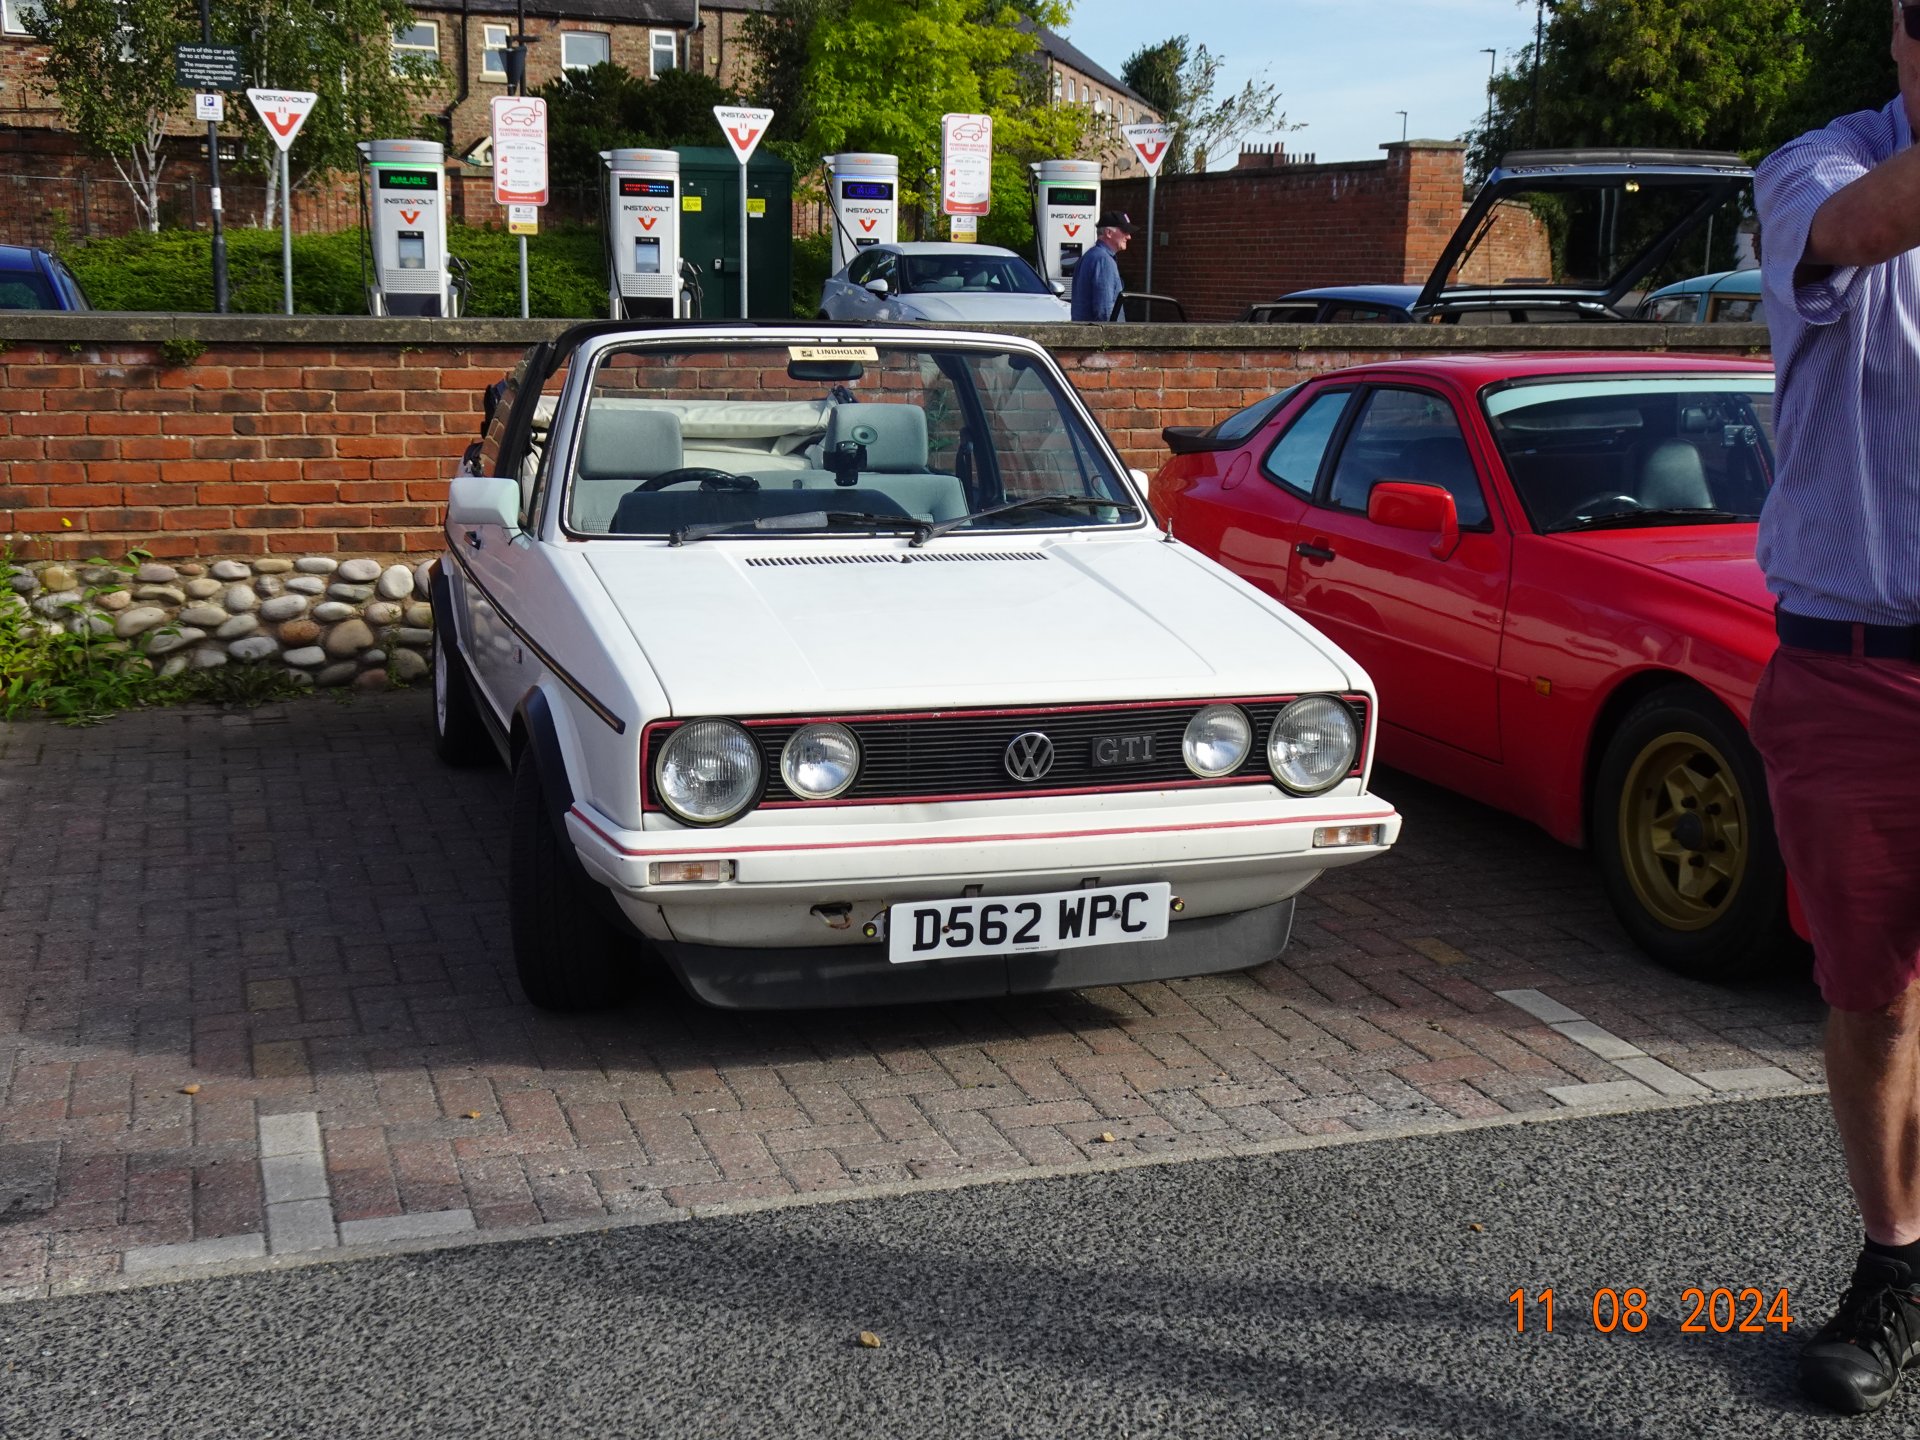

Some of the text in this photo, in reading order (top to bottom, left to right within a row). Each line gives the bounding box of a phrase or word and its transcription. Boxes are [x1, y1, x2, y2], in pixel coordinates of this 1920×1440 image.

[255, 94, 311, 104] INSTAVOLT
[721, 111, 769, 120] INSTAVOLT
[389, 176, 428, 185] AVAILABLE
[384, 197, 434, 206] INSTAVOLT
[623, 204, 671, 213] INSTAVOLT
[816, 348, 867, 356] LINDHOLME
[1096, 735, 1153, 765] GTI
[912, 891, 1149, 952] D562 WPC
